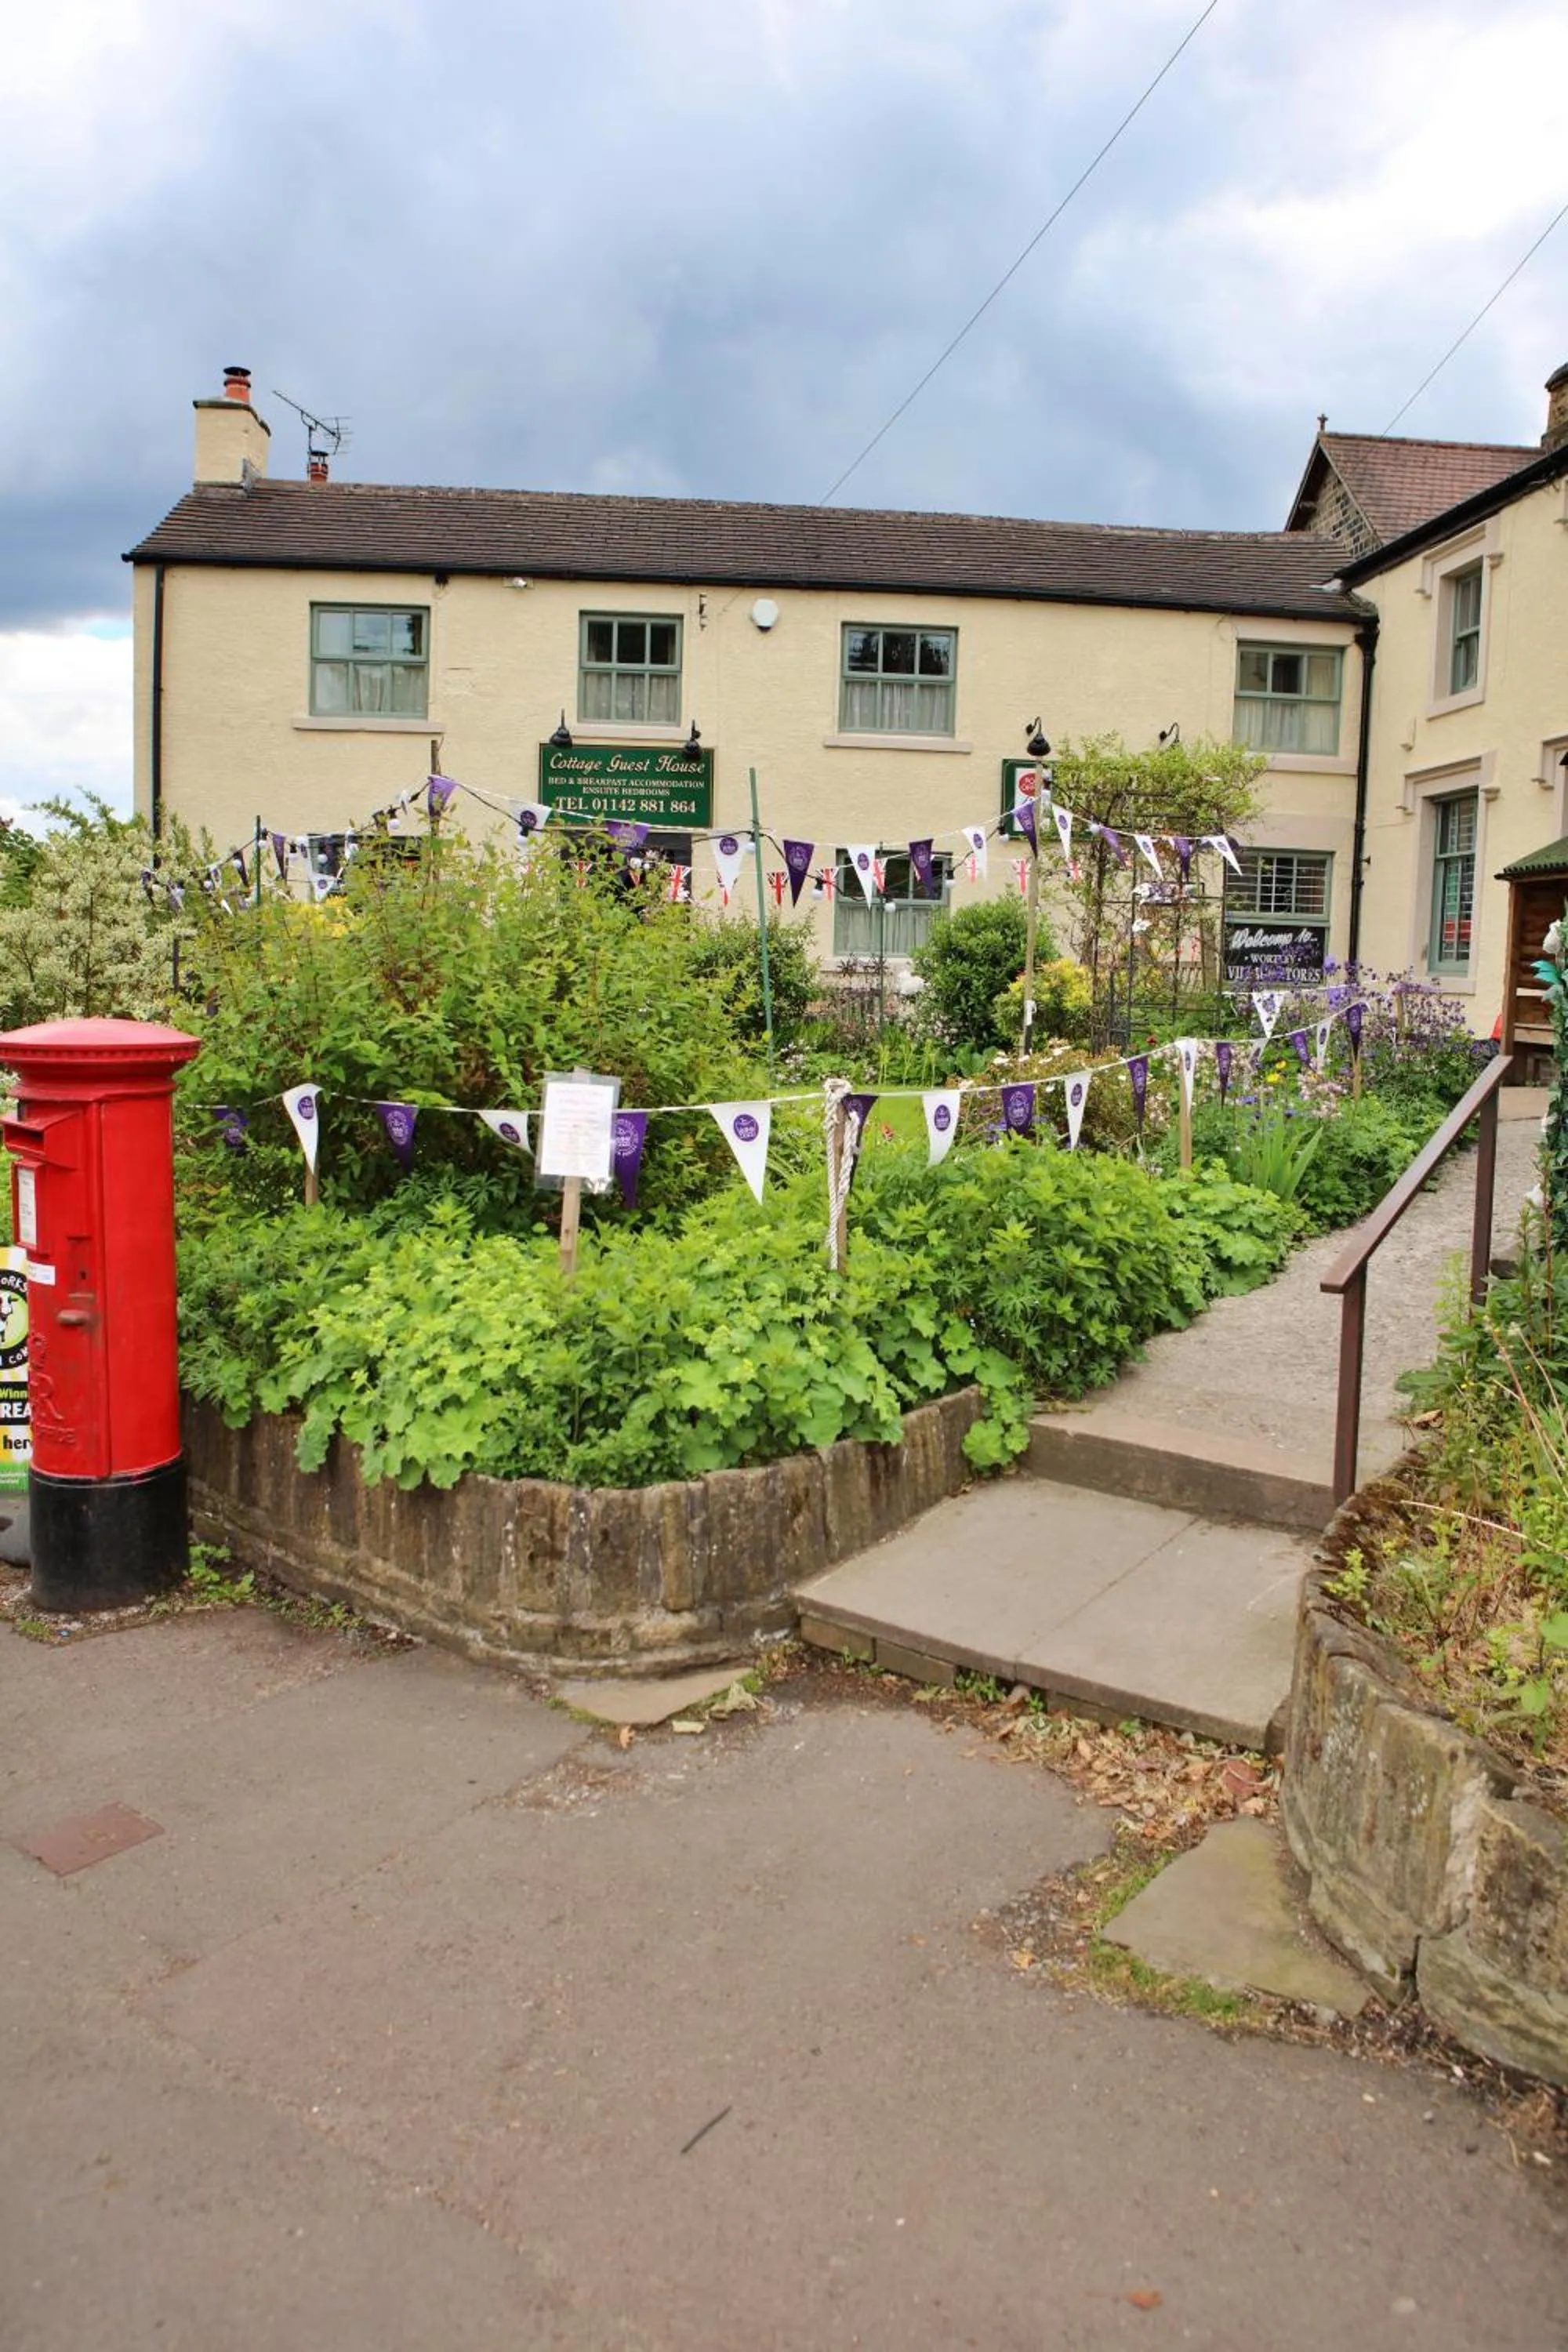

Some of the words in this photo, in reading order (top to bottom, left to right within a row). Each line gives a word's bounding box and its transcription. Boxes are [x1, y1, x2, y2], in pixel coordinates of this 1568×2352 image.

[550, 753, 602, 775] Cottage
[606, 754, 649, 772] Guest
[655, 755, 705, 773] House
[577, 777, 628, 786] BREAKFAST
[629, 779, 705, 789] ACCOMMODATION
[583, 786, 620, 795] ENSUITE
[622, 787, 670, 796] BEDROOMS
[556, 796, 588, 811] TEL
[591, 798, 636, 811] 01142
[639, 800, 665, 812] 881
[670, 800, 696, 813] 864
[1229, 927, 1293, 949] Welcome
[0, 1388, 28, 1399] Winn
[0, 1401, 32, 1418] REA
[2, 1434, 31, 1450] her
